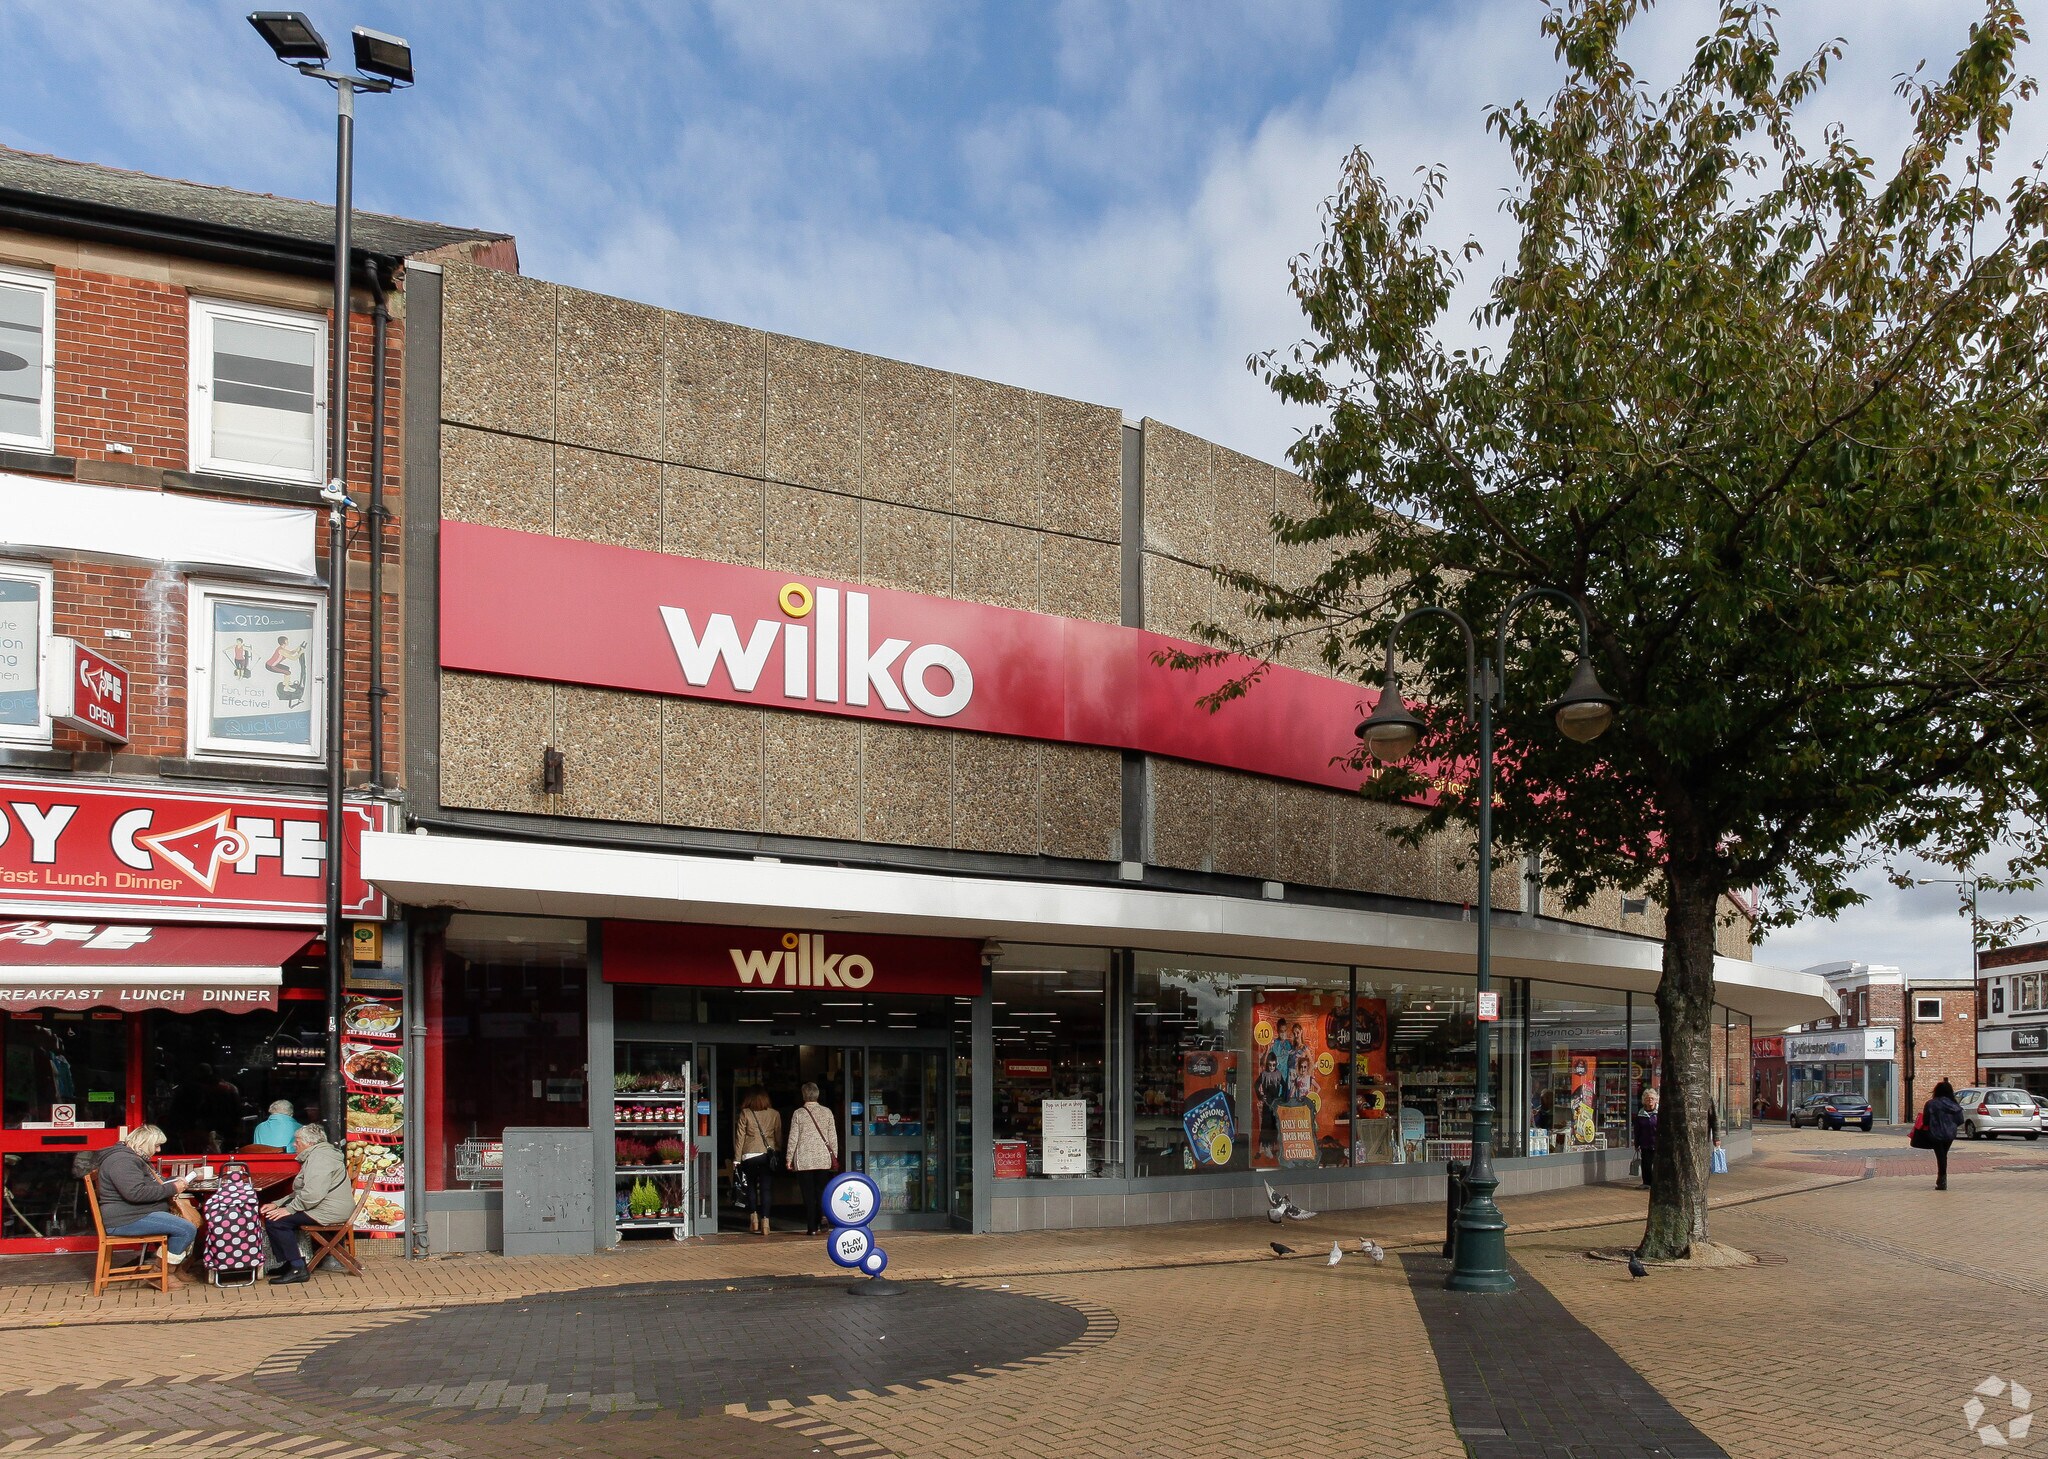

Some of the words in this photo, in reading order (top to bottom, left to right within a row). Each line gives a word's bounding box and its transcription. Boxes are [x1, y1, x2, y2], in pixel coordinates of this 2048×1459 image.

[659, 582, 974, 717] wilko
[79, 659, 123, 704] CAFE
[244, 686, 265, 698] Fast
[221, 696, 271, 709] Effective!
[88, 703, 115, 729] OPEN
[108, 807, 327, 894] CAFE
[45, 869, 108, 888] Lunch
[115, 872, 183, 891] Dinner
[729, 932, 875, 989] wilko
[120, 988, 186, 1001] LUNCH
[202, 989, 271, 1002] DINNER
[358, 1030, 397, 1039] BREAKFASTS
[359, 1078, 389, 1086] DINNERS
[1045, 1102, 1054, 1110] Pop
[1191, 1108, 1226, 1134] CHAMPIONS
[1281, 1119, 1296, 1129] ONLY
[1297, 1119, 1310, 1129] ONE
[355, 1126, 391, 1134] OMELETTES
[997, 1151, 1016, 1160] Order
[1016, 1151, 1022, 1159] &
[1285, 1148, 1313, 1159] CUSTOMER
[841, 1236, 862, 1249] PLAY
[843, 1244, 863, 1255] NOW
